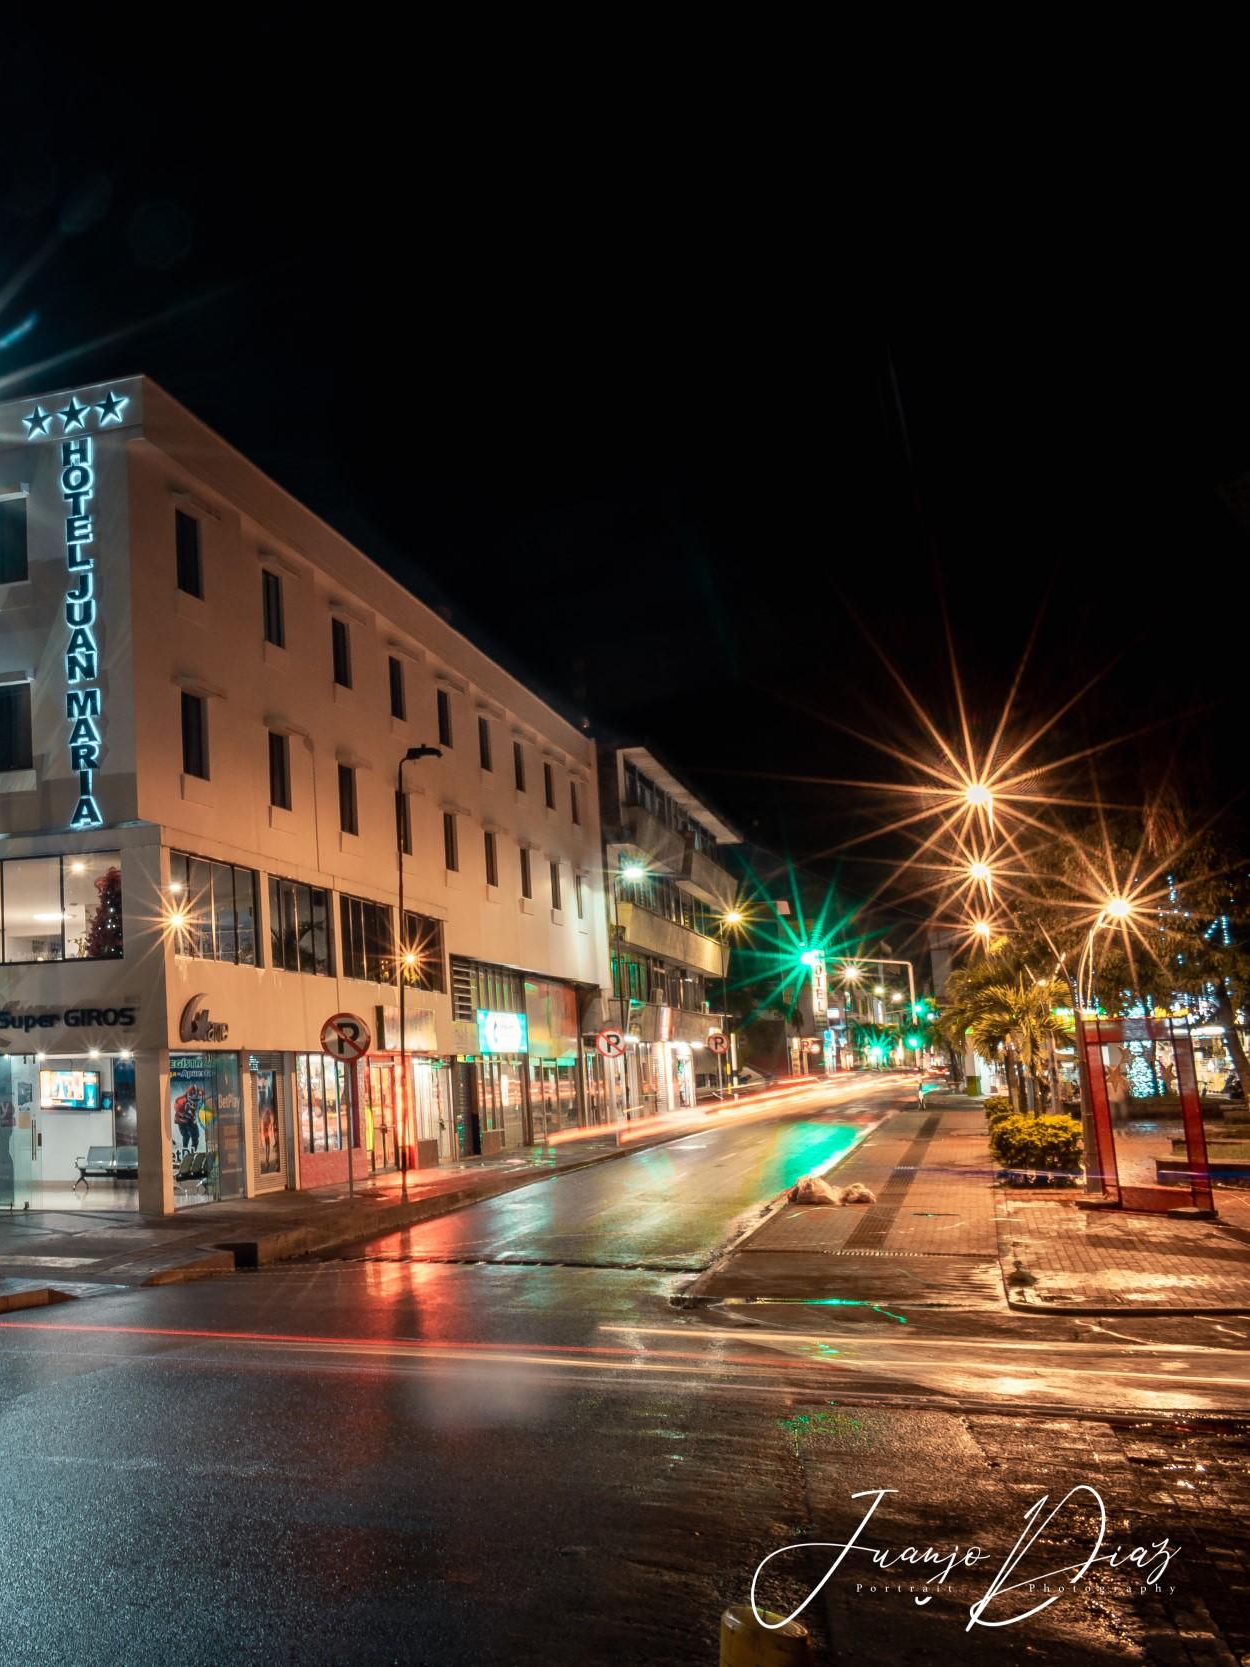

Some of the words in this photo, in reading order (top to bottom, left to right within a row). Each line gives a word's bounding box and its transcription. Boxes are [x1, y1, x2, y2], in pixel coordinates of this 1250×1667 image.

[62, 437, 95, 571] HOTEL
[65, 573, 98, 683] JUAN
[65, 689, 103, 828] MARIA
[63, 1007, 137, 1028] GIROS
